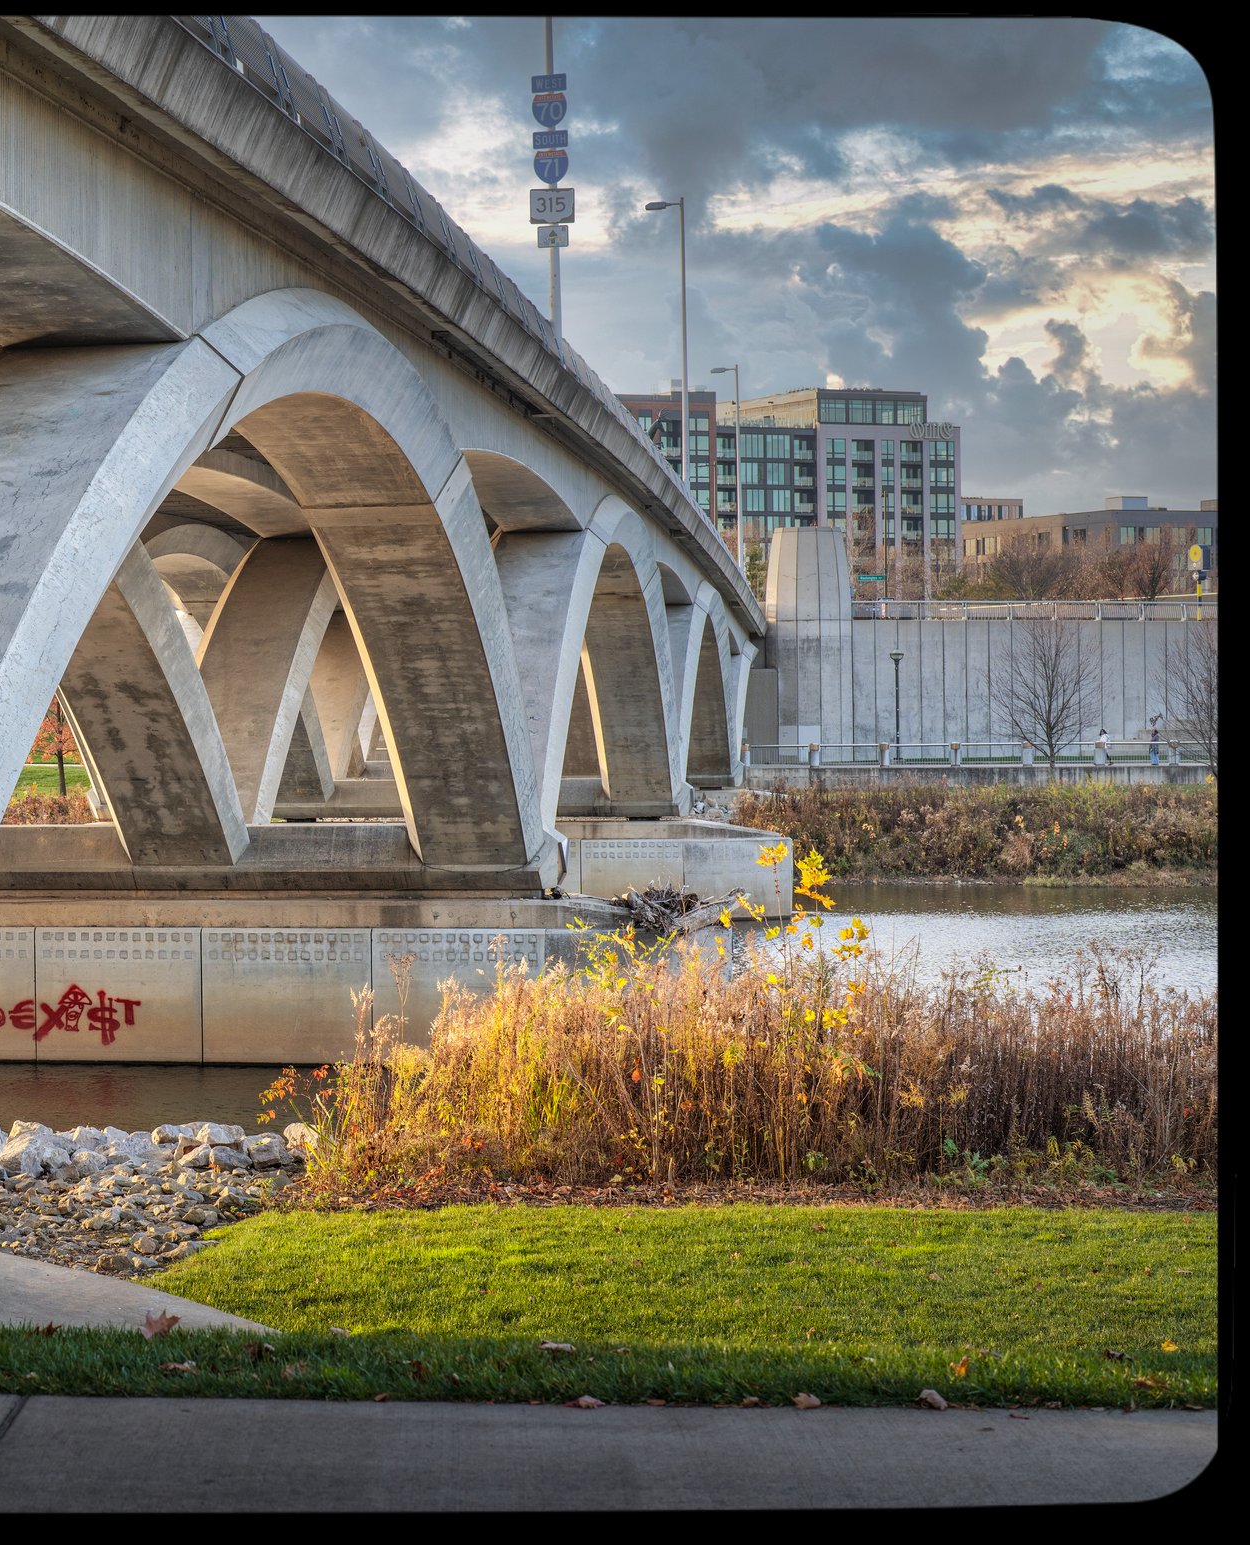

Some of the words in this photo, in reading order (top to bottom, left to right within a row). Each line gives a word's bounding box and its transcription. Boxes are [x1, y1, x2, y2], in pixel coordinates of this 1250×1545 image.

[535, 78, 563, 90] WEST
[536, 102, 563, 121] 70
[535, 134, 566, 146] SOUTH
[539, 159, 559, 178] 71
[536, 197, 566, 213] 315
